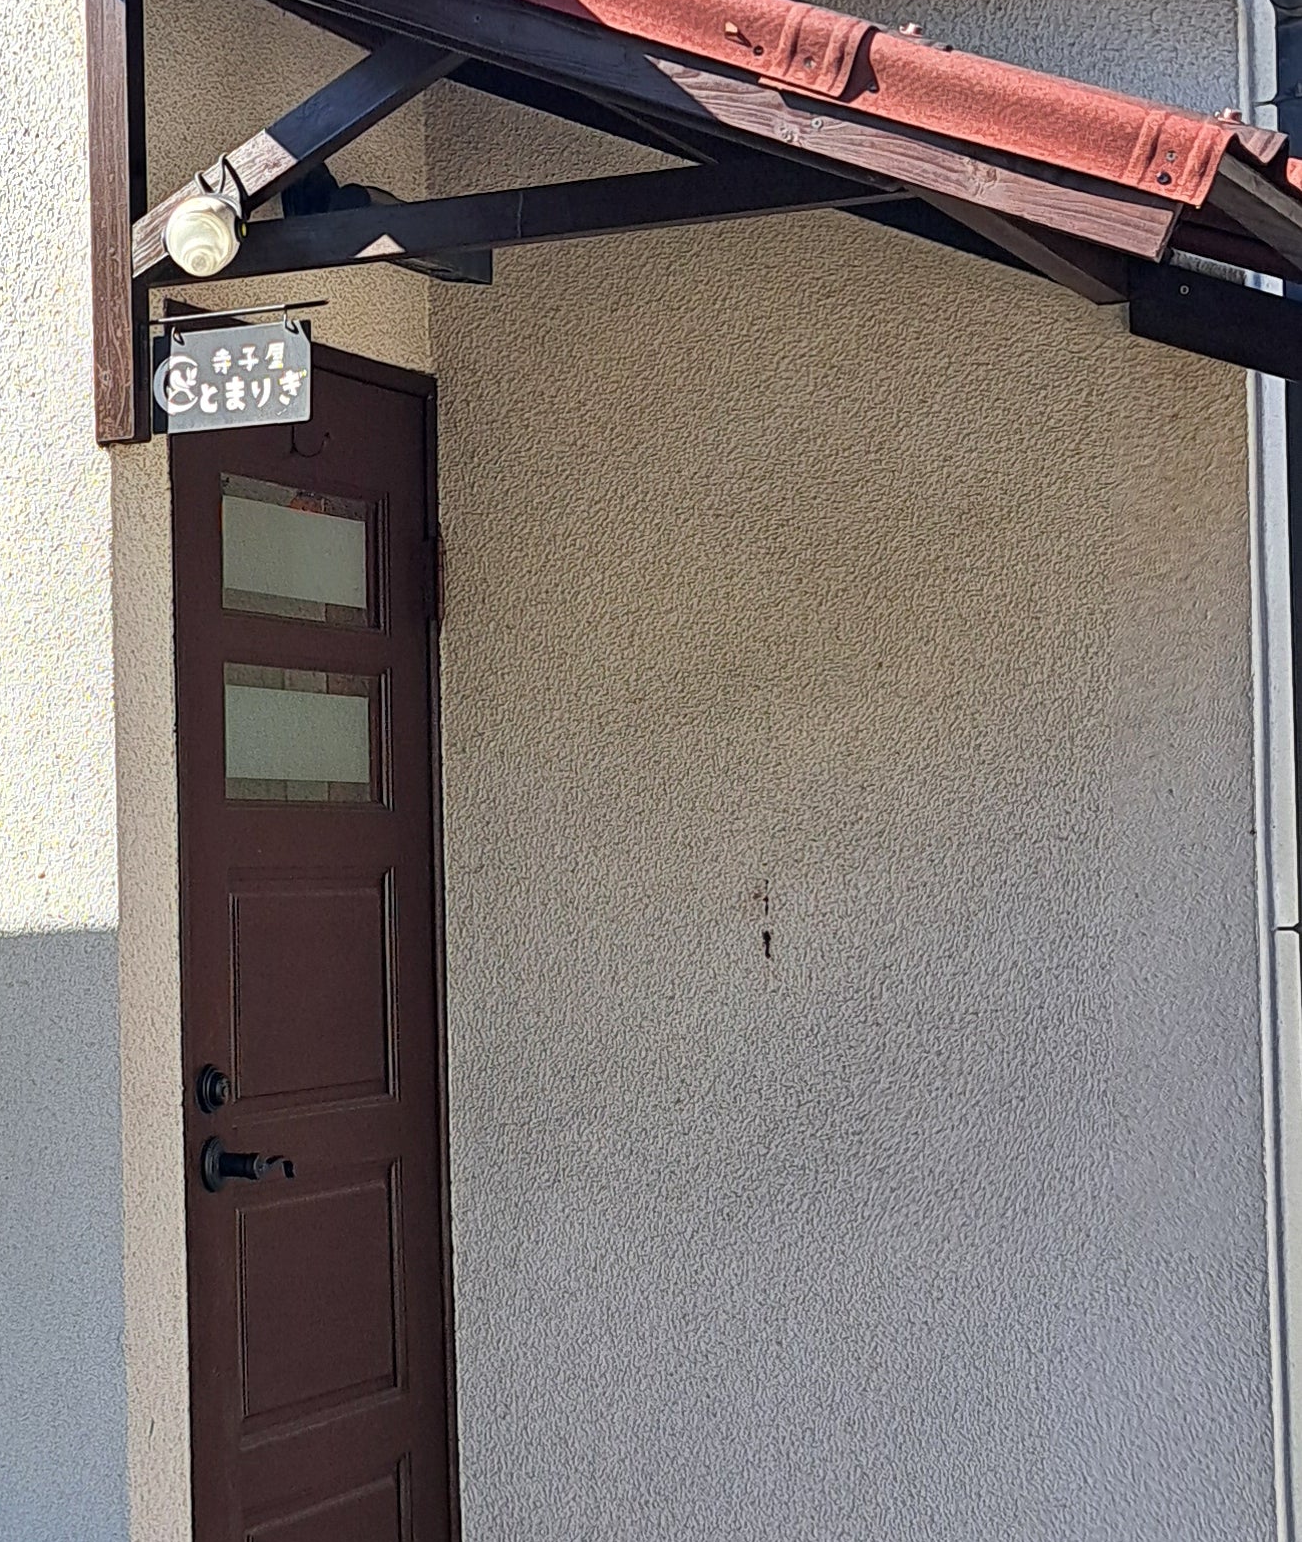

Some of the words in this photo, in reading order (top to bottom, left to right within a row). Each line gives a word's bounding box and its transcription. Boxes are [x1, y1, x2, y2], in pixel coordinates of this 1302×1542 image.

[212, 342, 285, 374] 寺子屋
[200, 369, 307, 413] とまりぎ
